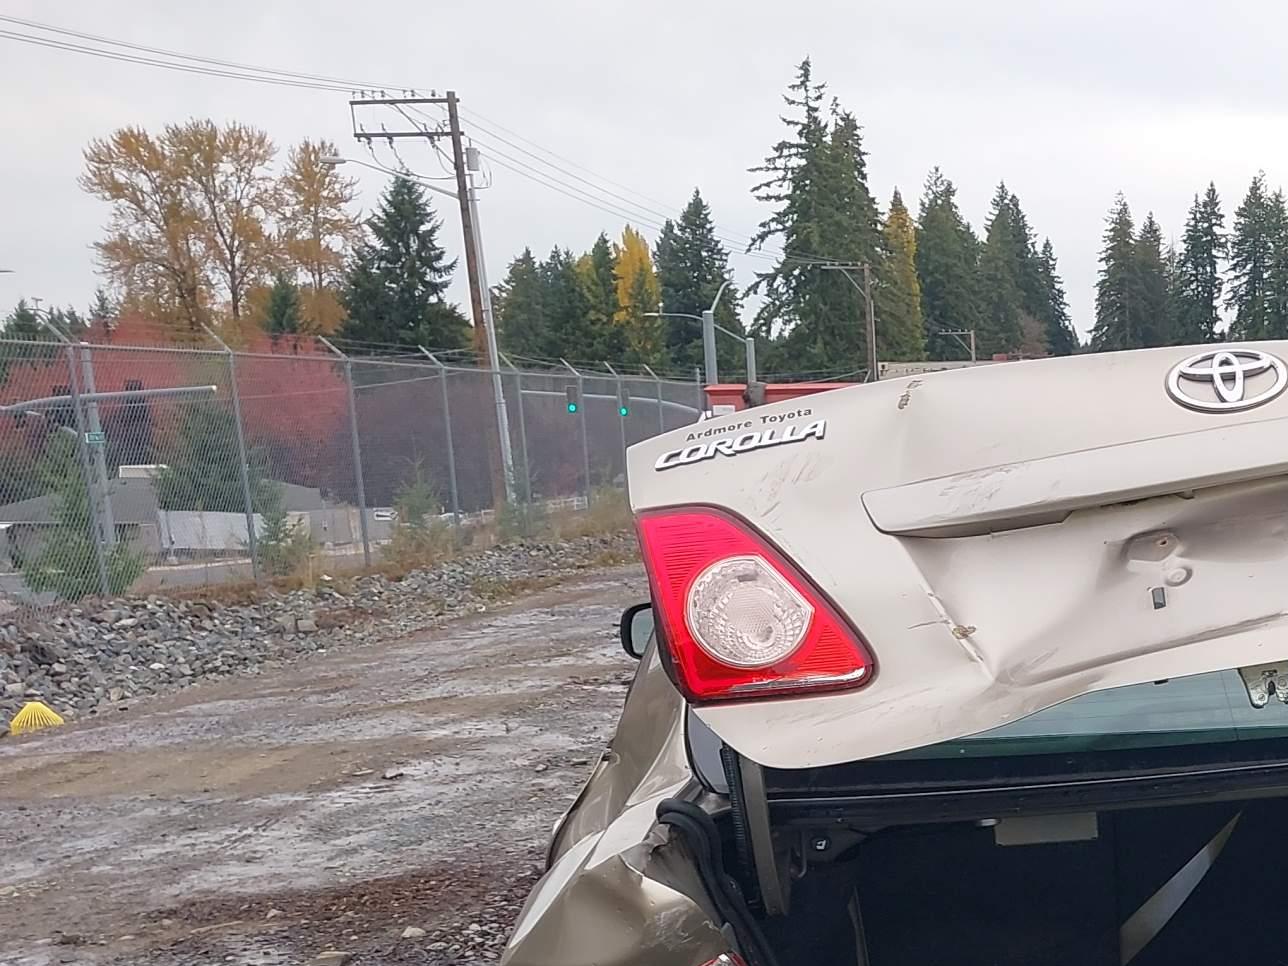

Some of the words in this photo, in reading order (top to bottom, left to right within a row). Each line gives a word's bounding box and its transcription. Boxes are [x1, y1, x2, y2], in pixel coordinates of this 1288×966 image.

[655, 419, 827, 472] COROLLA
[686, 420, 753, 442] Ardmore
[759, 408, 813, 425] Toyota
